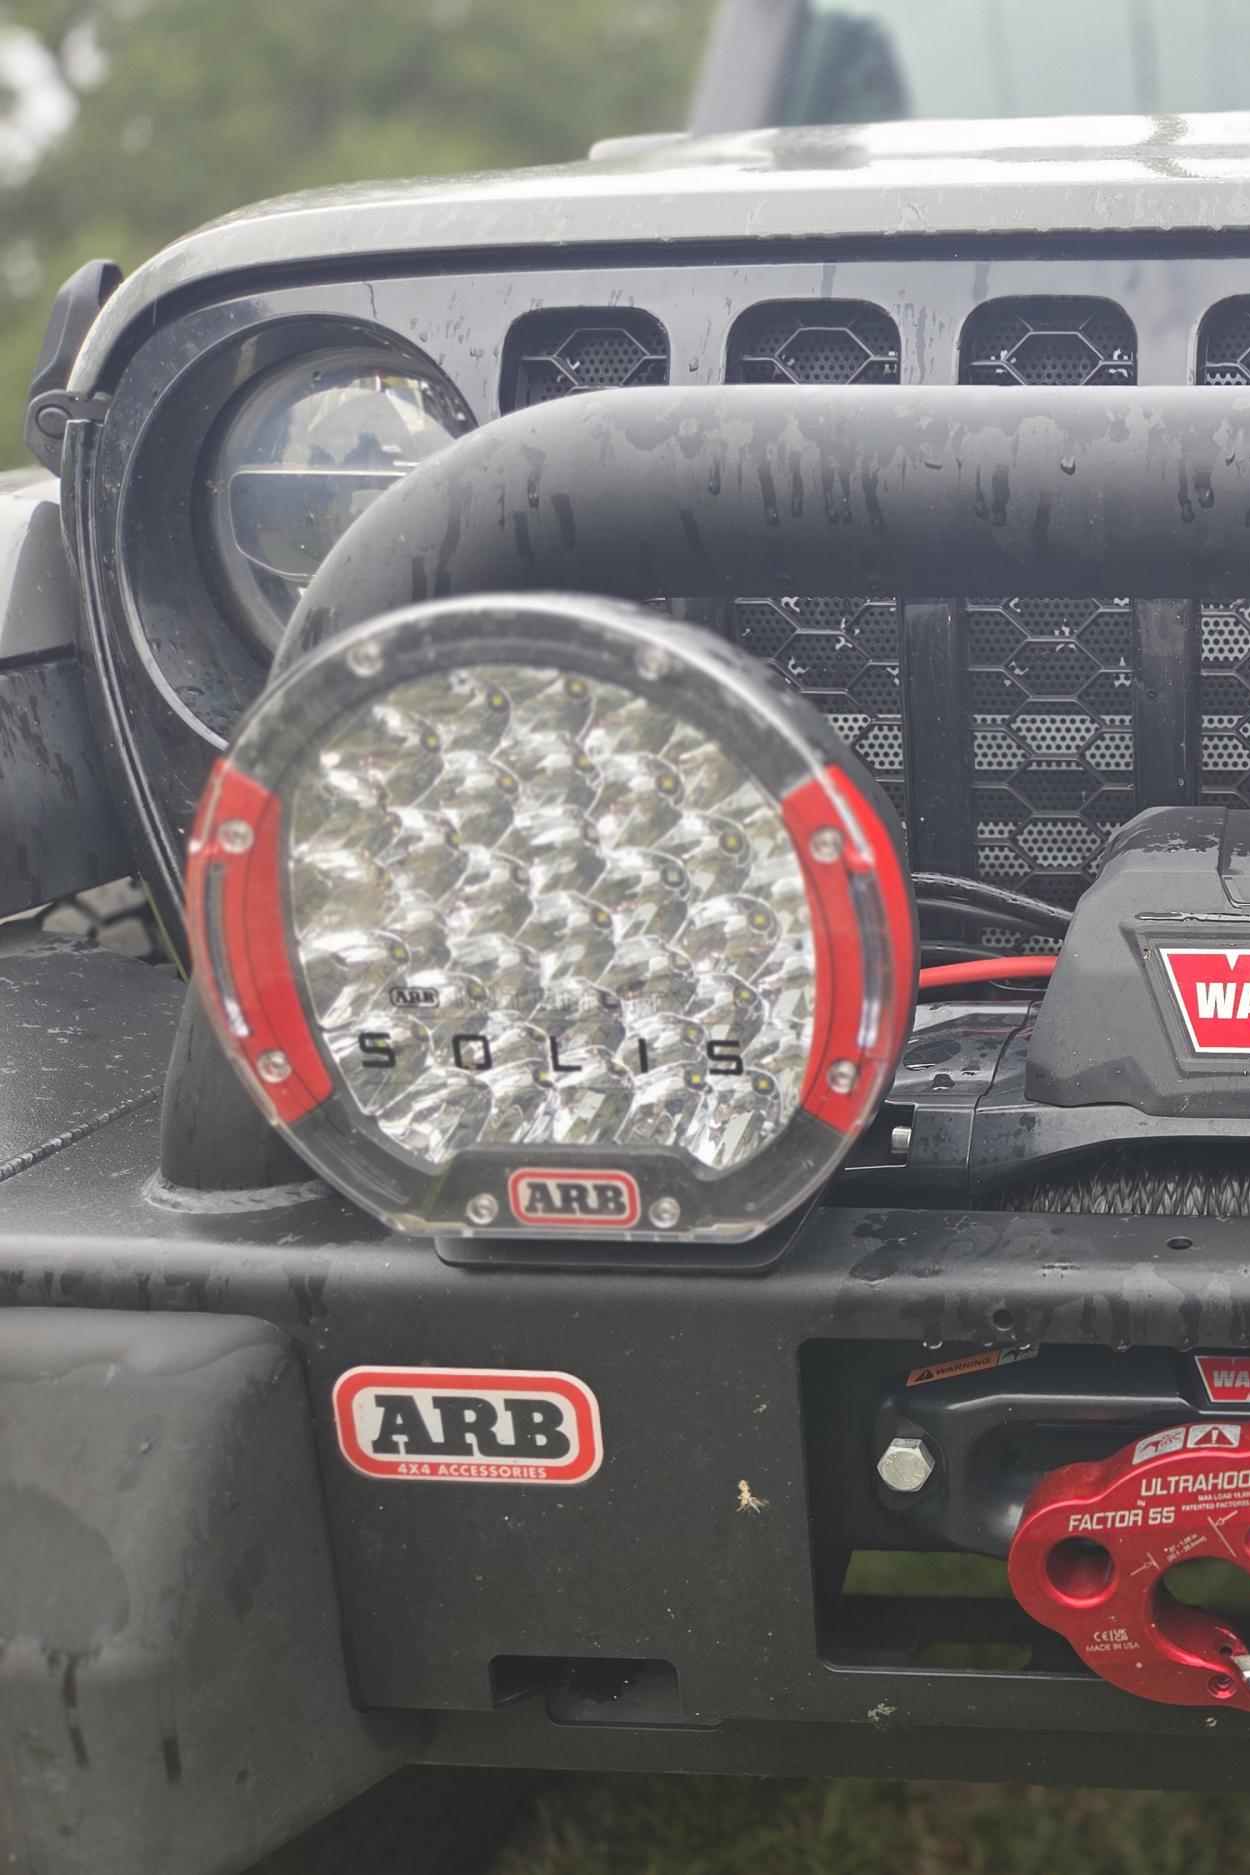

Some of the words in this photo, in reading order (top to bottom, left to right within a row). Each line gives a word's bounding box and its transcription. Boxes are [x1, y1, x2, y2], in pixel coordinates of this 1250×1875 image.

[358, 1032, 744, 1076] SOLIS
[525, 1181, 627, 1215] ARB
[935, 1357, 991, 1374] WARNING
[371, 1394, 571, 1459] ARB
[397, 1463, 430, 1475] 4X4
[437, 1464, 547, 1479] ACCESSORIES
[1068, 1510, 1143, 1532] FACTOR
[1148, 1507, 1175, 1525] 55
[1085, 1643, 1111, 1652] MADE
[1123, 1641, 1139, 1649] USA
